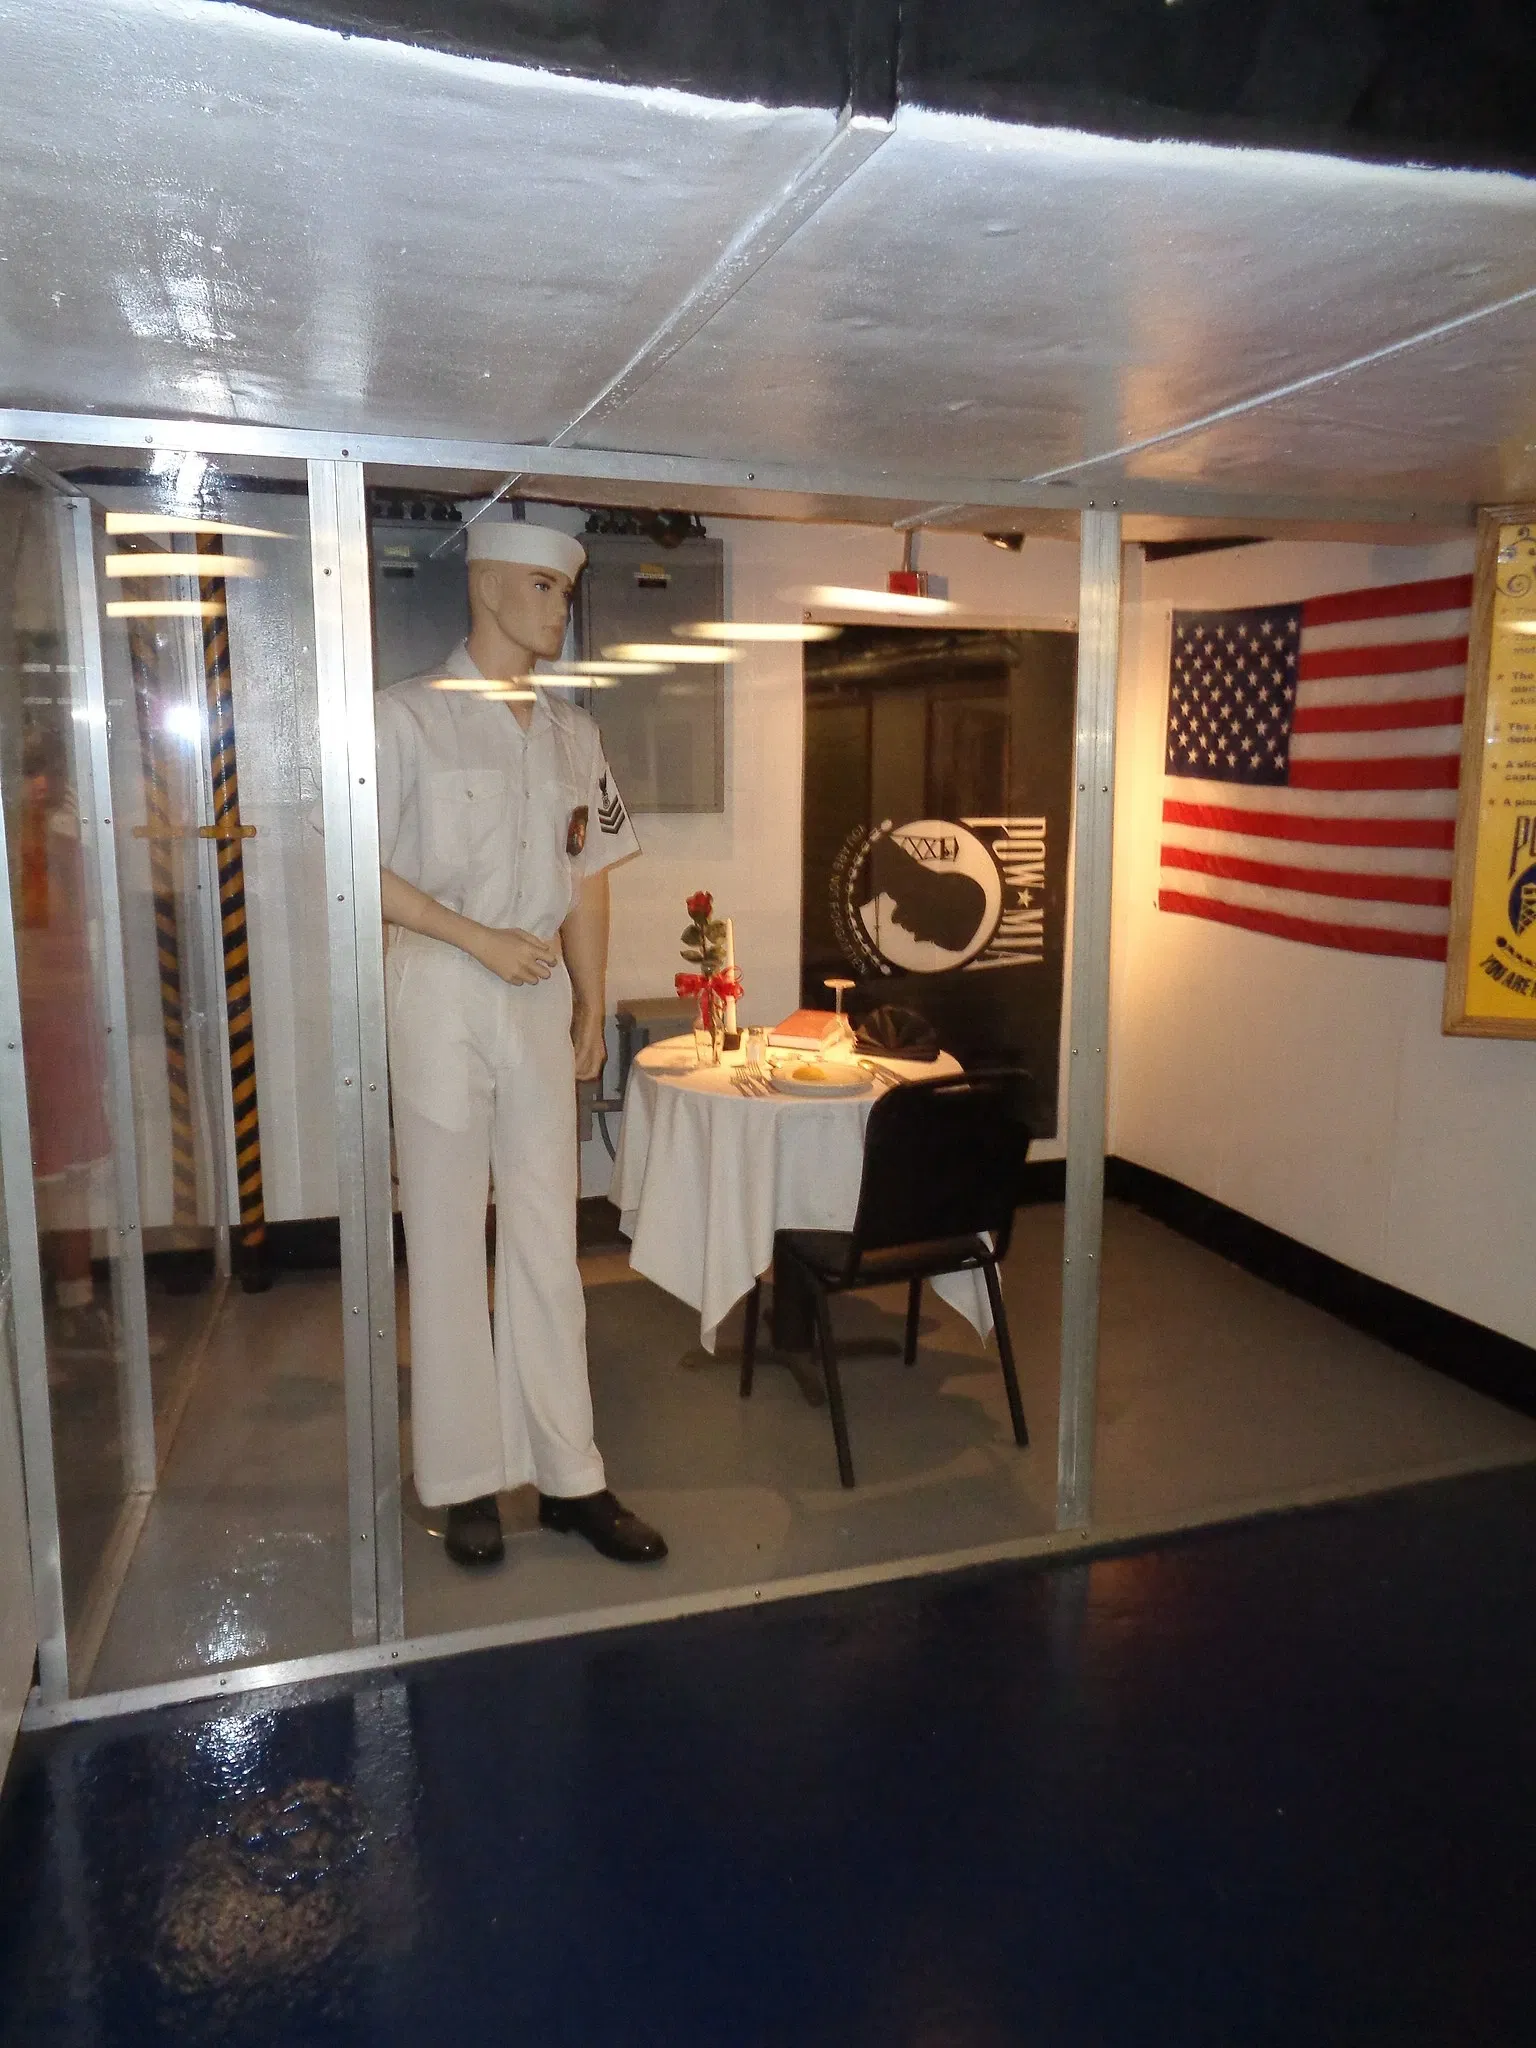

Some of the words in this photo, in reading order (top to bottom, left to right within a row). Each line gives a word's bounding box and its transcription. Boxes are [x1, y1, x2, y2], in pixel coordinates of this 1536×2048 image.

[1512, 671, 1535, 680] The
[961, 817, 1047, 889] POW
[963, 908, 1044, 972] MIA
[1501, 971, 1532, 996] ARE
